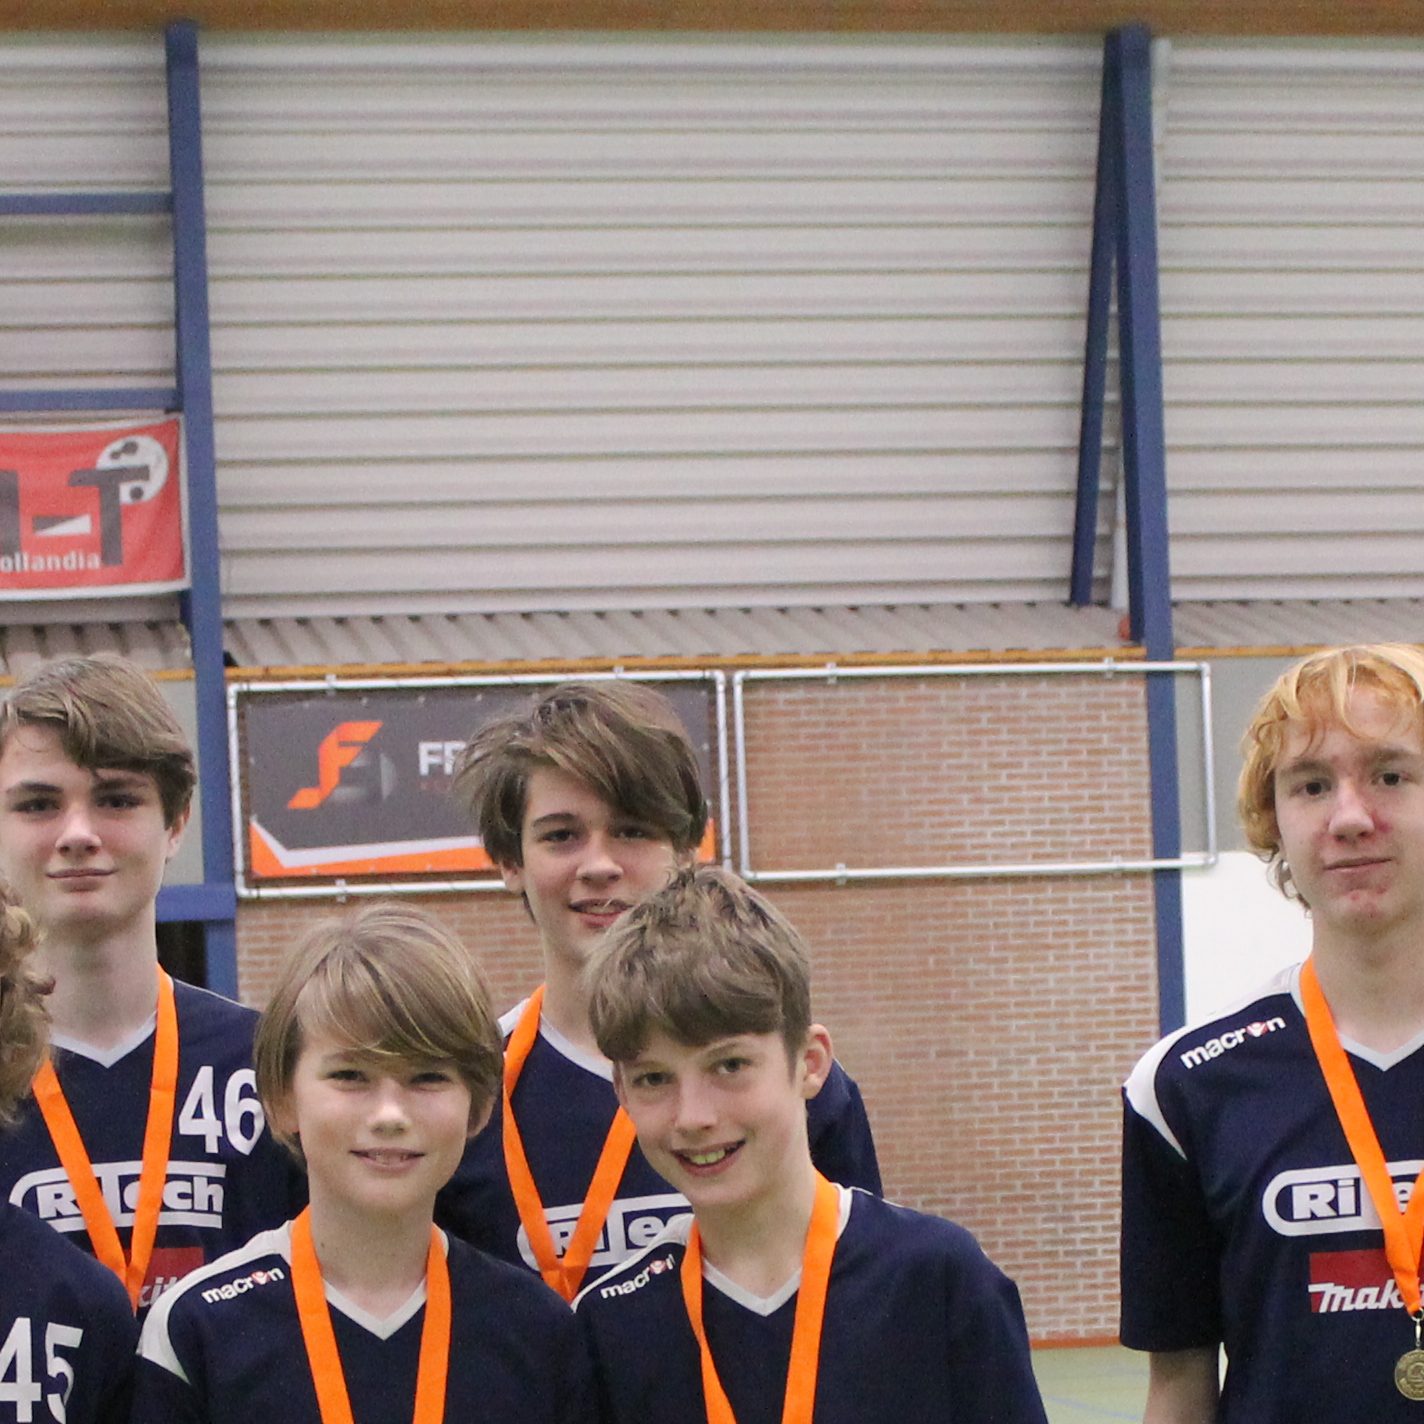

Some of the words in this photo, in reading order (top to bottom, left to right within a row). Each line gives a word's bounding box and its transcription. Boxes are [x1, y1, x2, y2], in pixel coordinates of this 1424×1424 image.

[1180, 1015, 1286, 1069] macron
[178, 1065, 266, 1156] 46
[201, 1265, 285, 1304] macron
